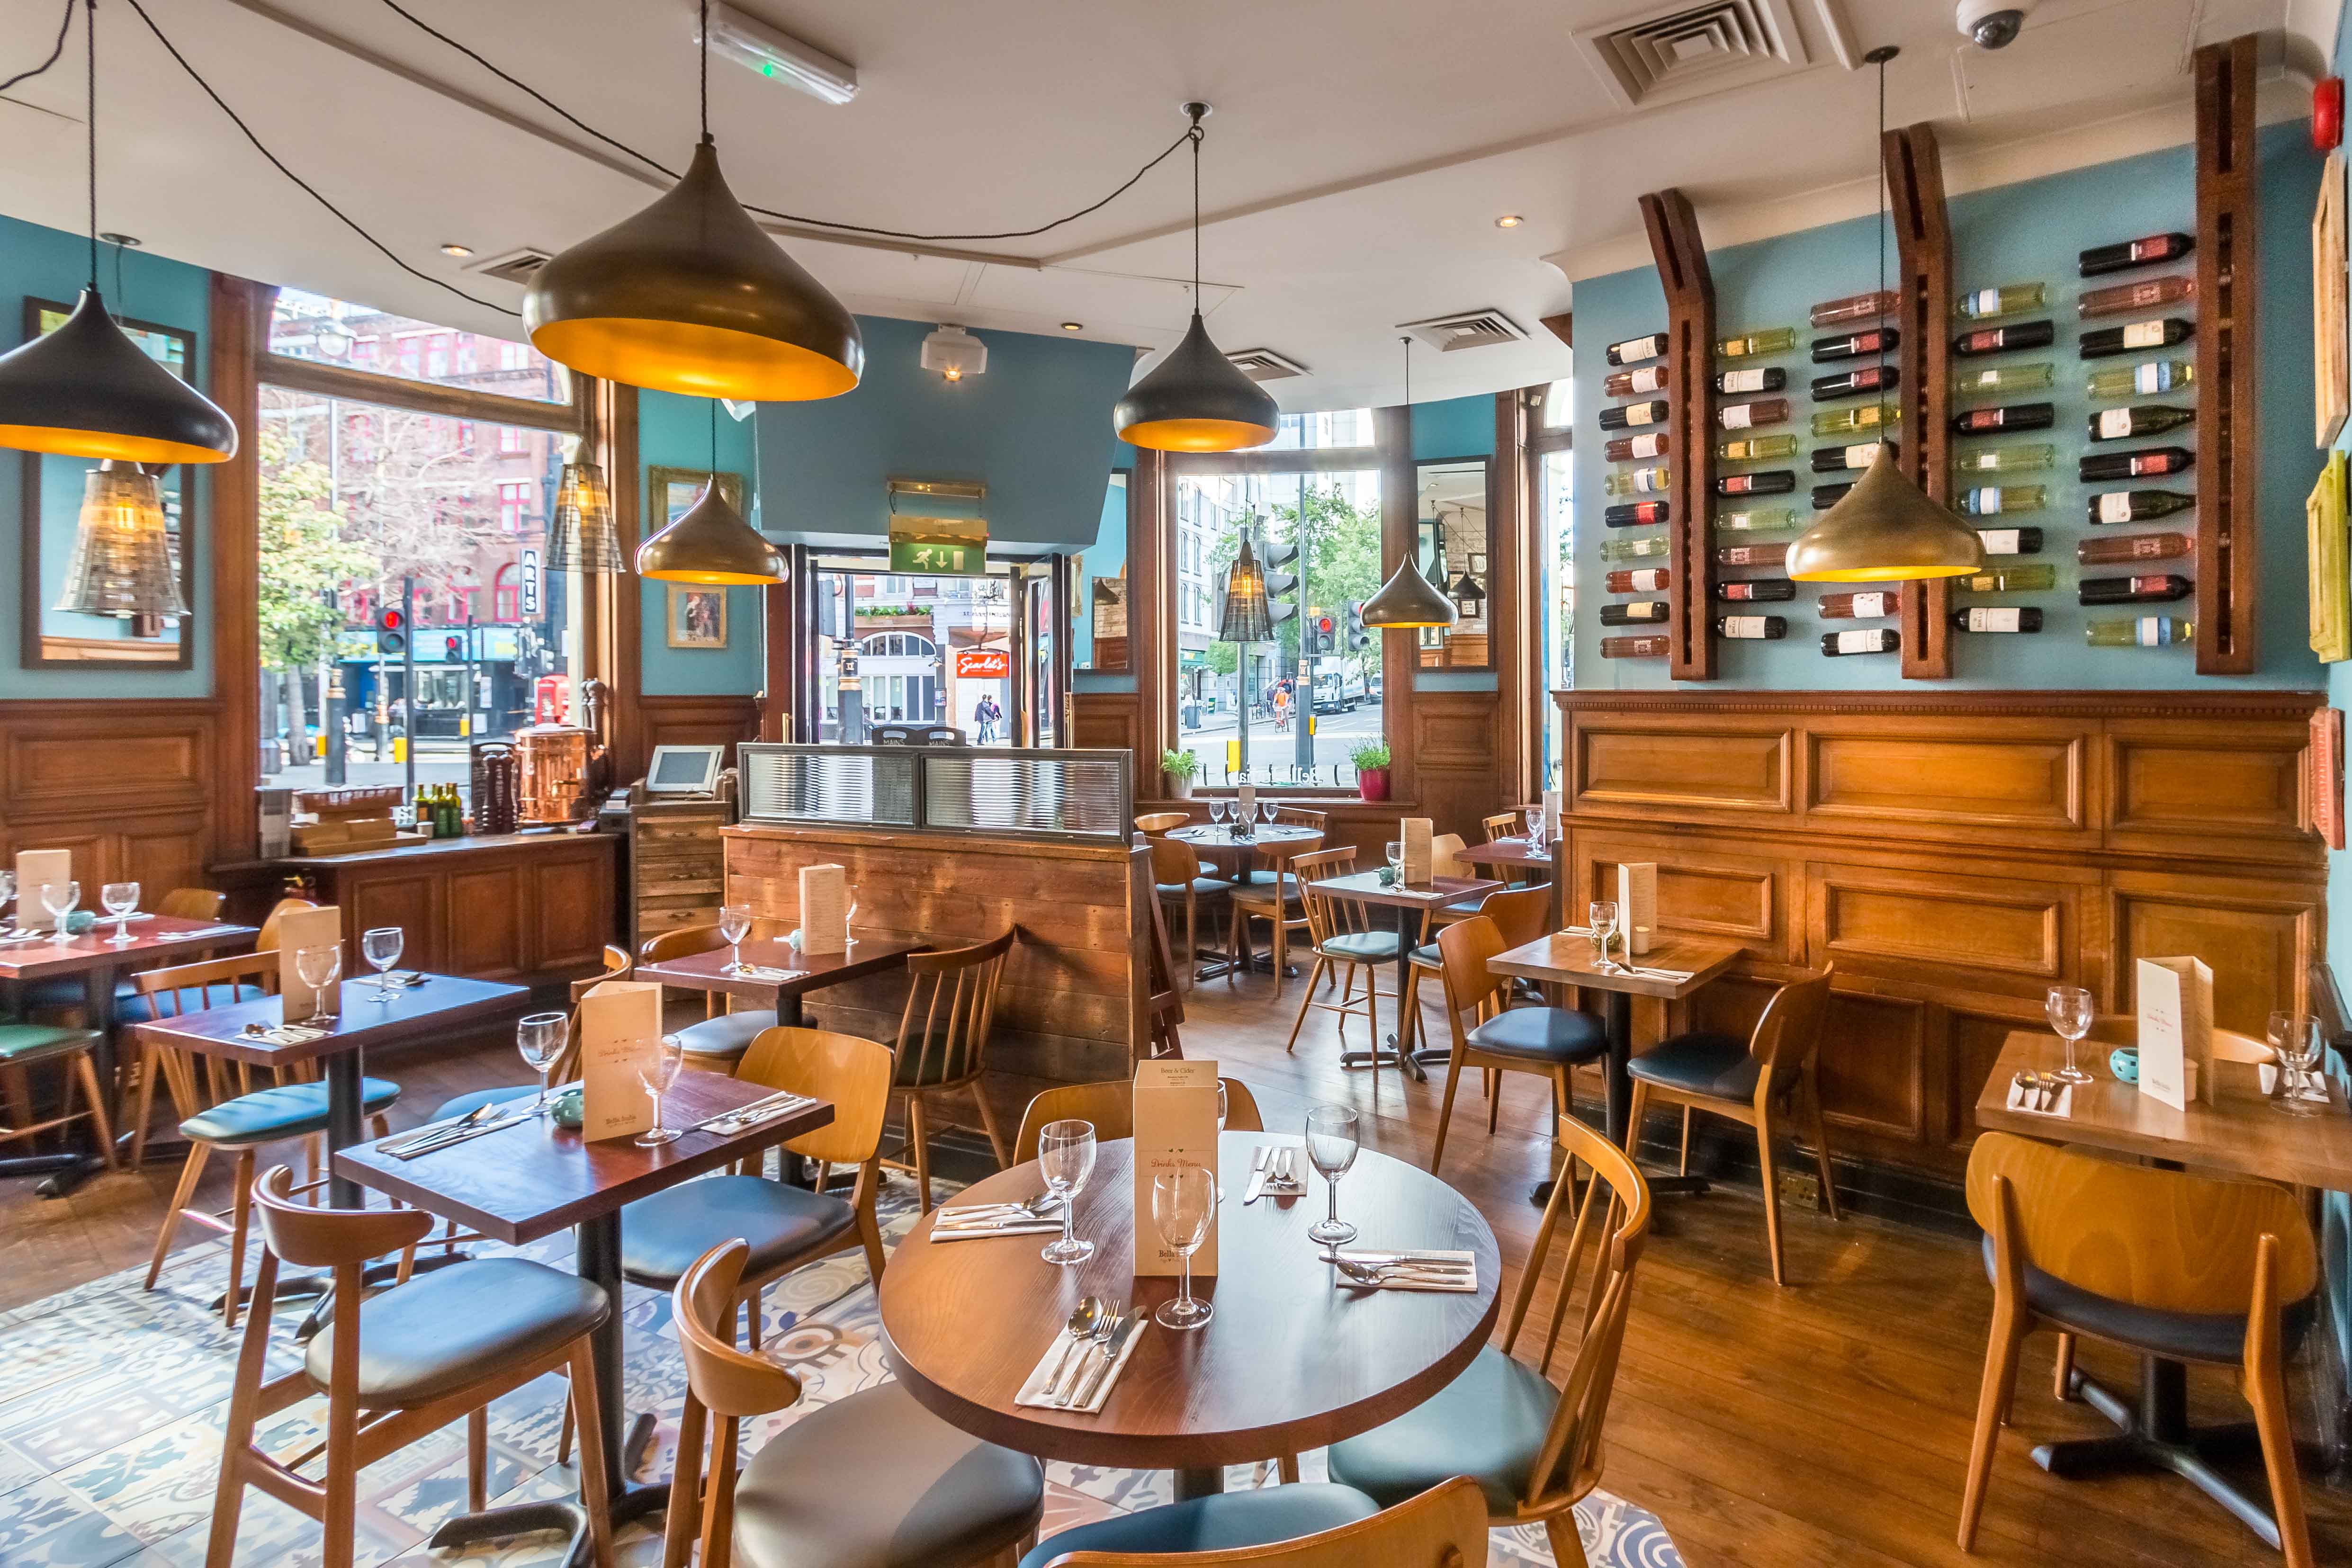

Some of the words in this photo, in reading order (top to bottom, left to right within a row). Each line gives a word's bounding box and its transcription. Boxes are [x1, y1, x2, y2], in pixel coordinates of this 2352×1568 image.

[524, 553, 536, 610] ARTS
[960, 657, 1005, 674] Scarlet's
[1151, 1158, 1175, 1167] Drinks
[1177, 1158, 1201, 1167] Menu
